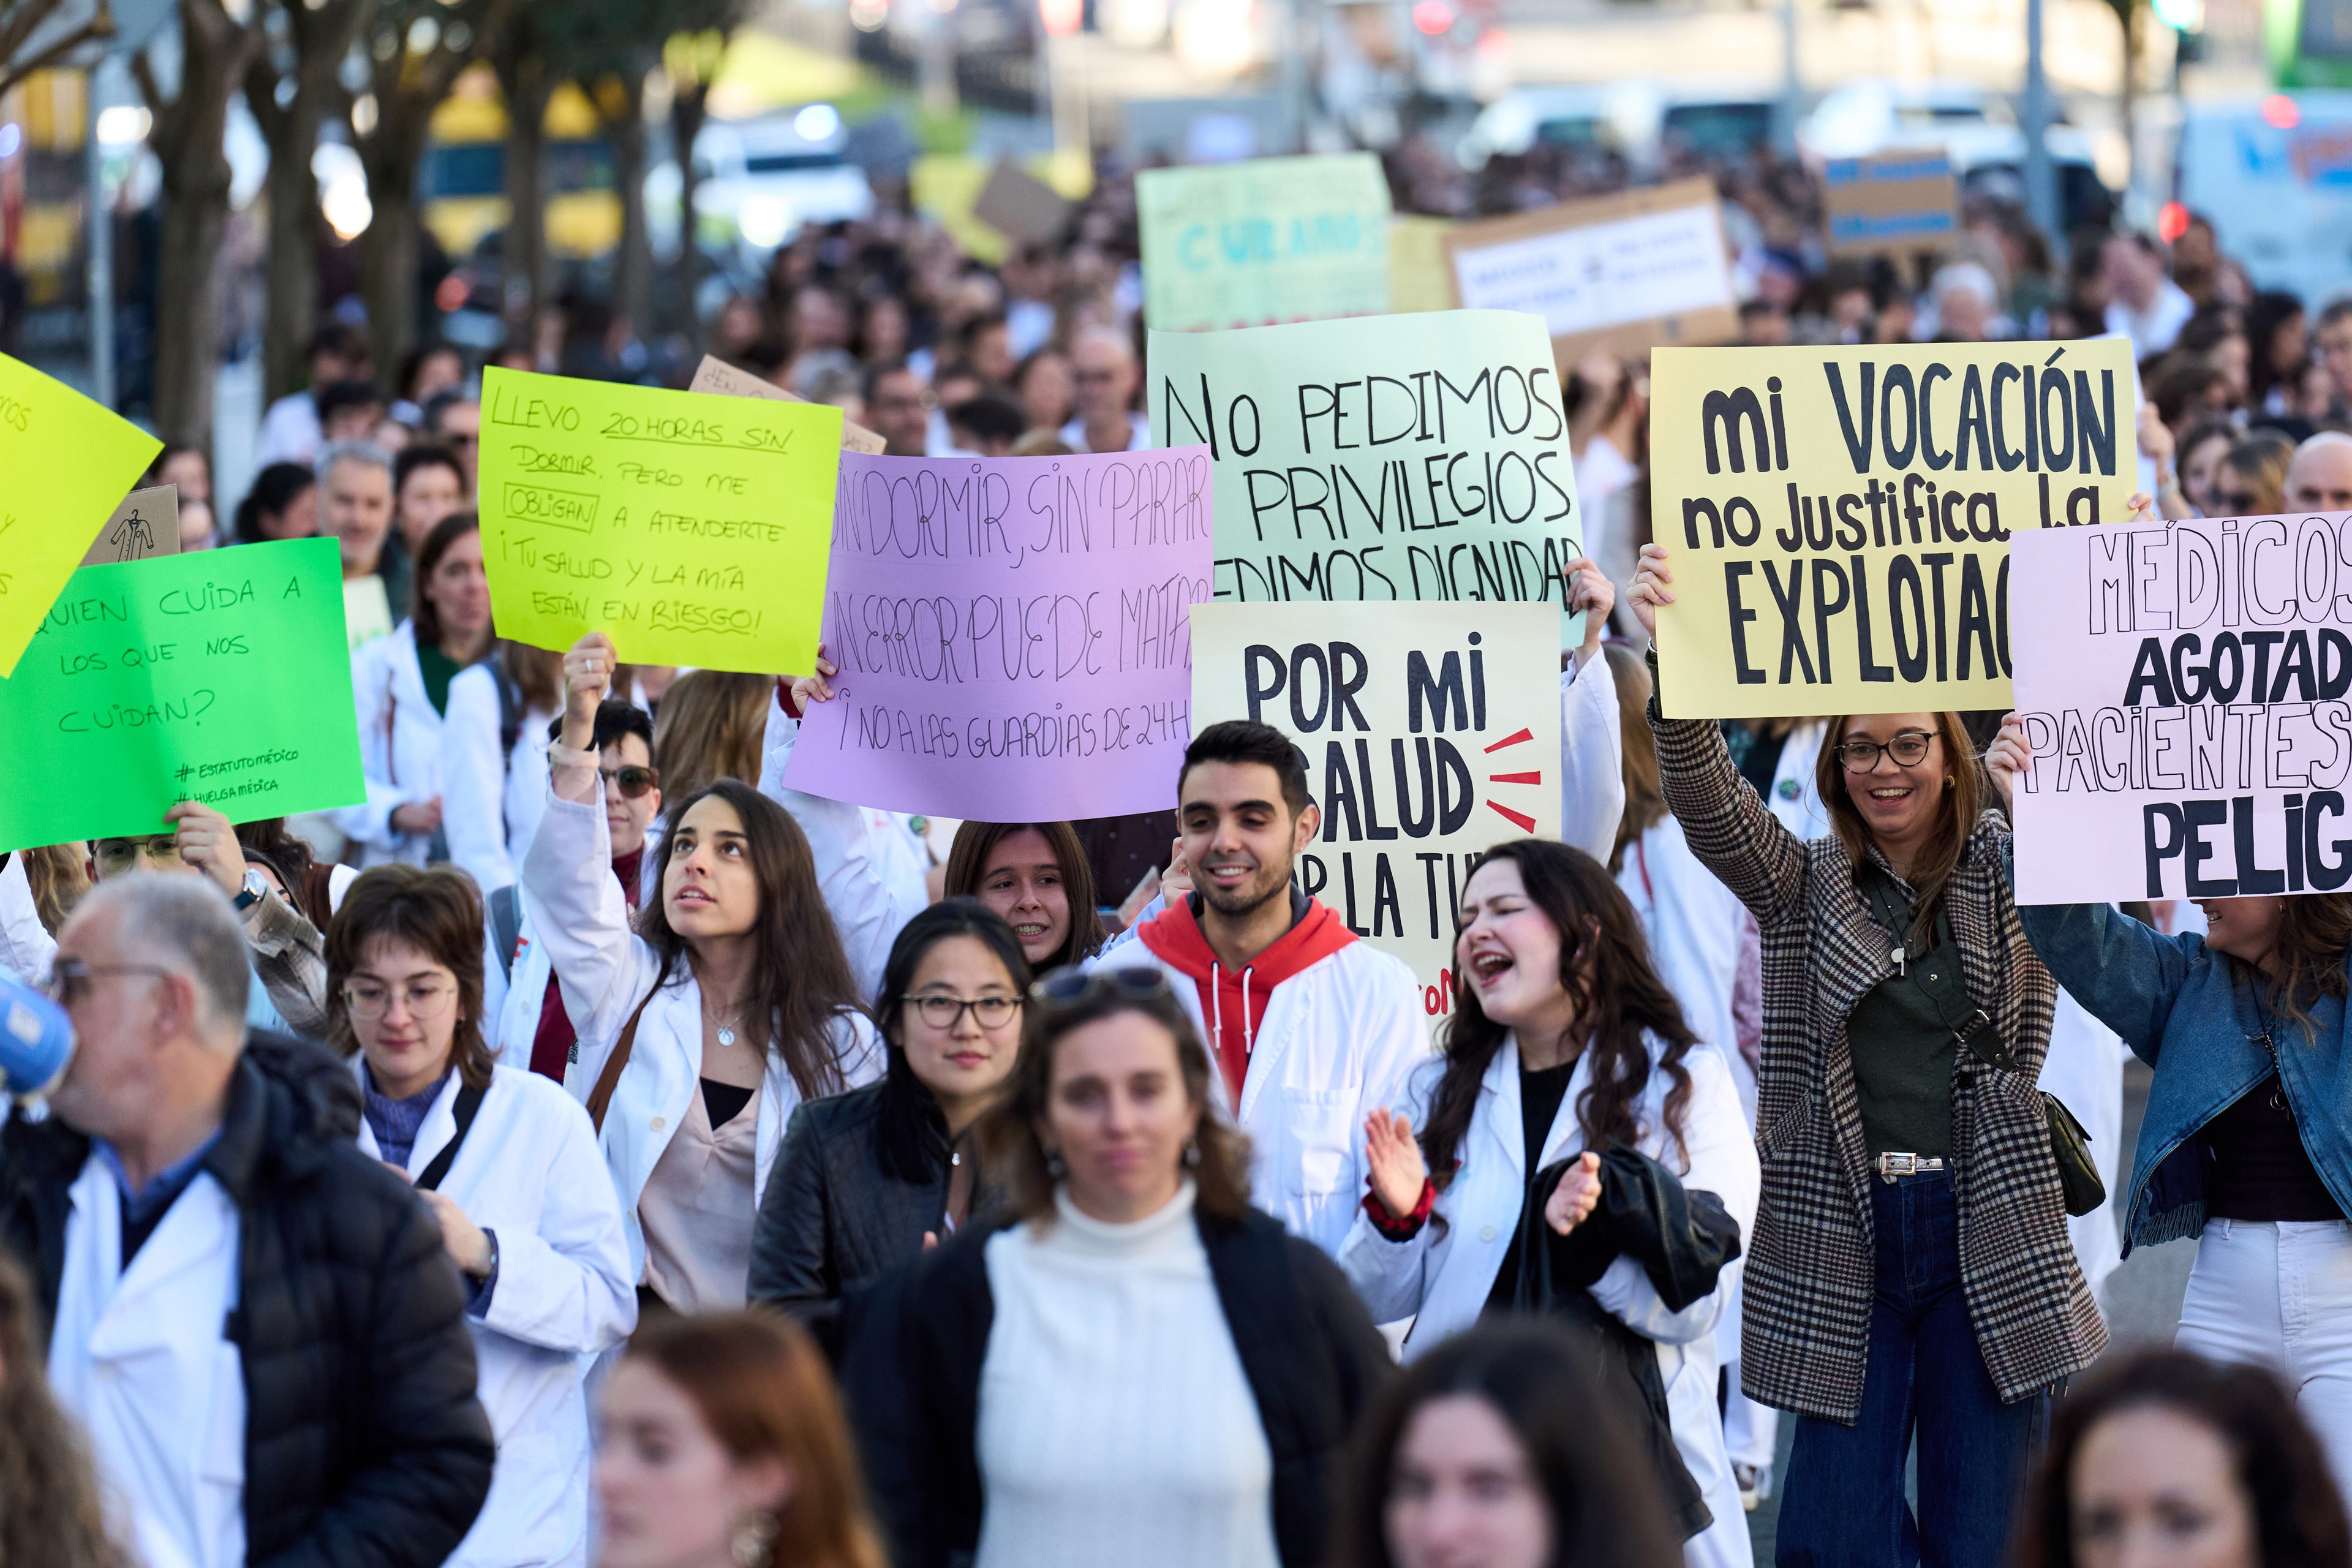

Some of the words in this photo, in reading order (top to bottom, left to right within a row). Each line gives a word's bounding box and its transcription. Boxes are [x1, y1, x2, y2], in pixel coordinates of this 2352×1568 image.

[492, 385, 580, 431] LLEVO
[599, 412, 639, 435] 20
[646, 418, 723, 443] HORAS
[1298, 366, 1562, 454] PEDIMOS
[1823, 347, 2116, 476] VOCACIÓN
[617, 462, 683, 488] PERO
[706, 473, 750, 495] ME
[1099, 454, 1208, 549] PARAR
[1243, 451, 1571, 541] PRIVILEGIOS
[613, 507, 627, 527] A
[649, 512, 786, 543] ATENDERTE
[1682, 495, 1762, 550] no
[283, 576, 301, 599] A
[543, 551, 612, 579] SALUD
[627, 559, 644, 587] Y
[652, 565, 685, 587] LA
[603, 600, 640, 620] EN
[863, 594, 964, 684] ERROR
[968, 592, 1102, 682] PUEDE
[60, 653, 107, 675] LOS
[122, 644, 178, 669] QUE
[206, 635, 249, 657] NOS
[1244, 641, 1371, 733] POR
[2123, 628, 2352, 706] AGOTAD
[897, 710, 916, 754] A
[921, 714, 959, 759] LAS
[1103, 707, 1131, 752] DE
[1289, 737, 1474, 842] ALUD
[1343, 852, 1404, 938] LA
